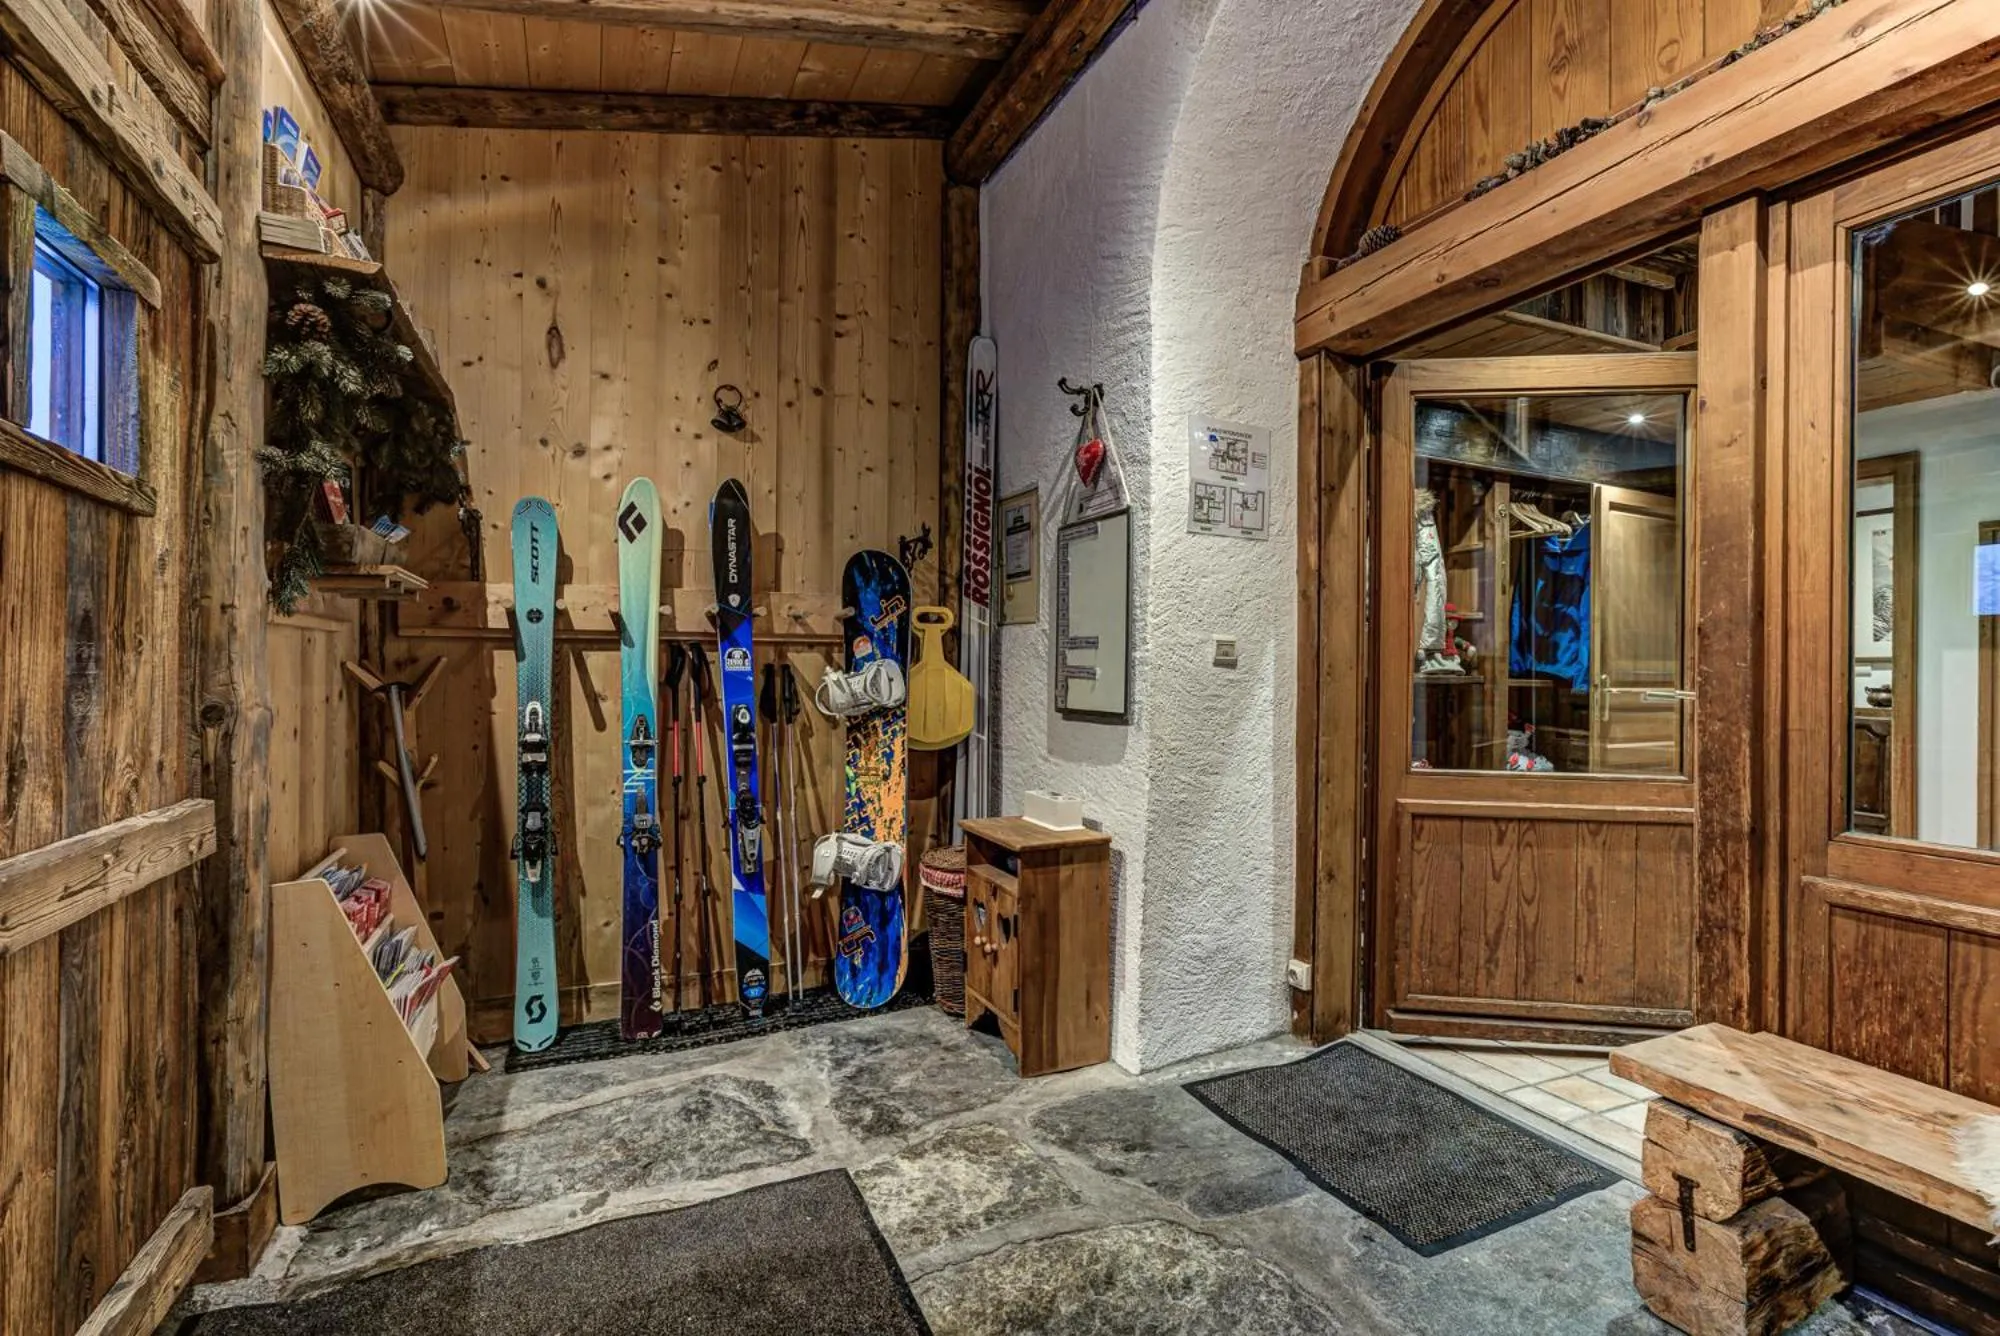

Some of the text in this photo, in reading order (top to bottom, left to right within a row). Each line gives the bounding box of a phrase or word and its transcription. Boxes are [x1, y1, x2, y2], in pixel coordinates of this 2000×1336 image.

[530, 521, 540, 585] SCOTT
[728, 518, 738, 584] DYNASTAR
[972, 466, 992, 609] ROSSIGNOL
[650, 919, 661, 998] Black Diamond
